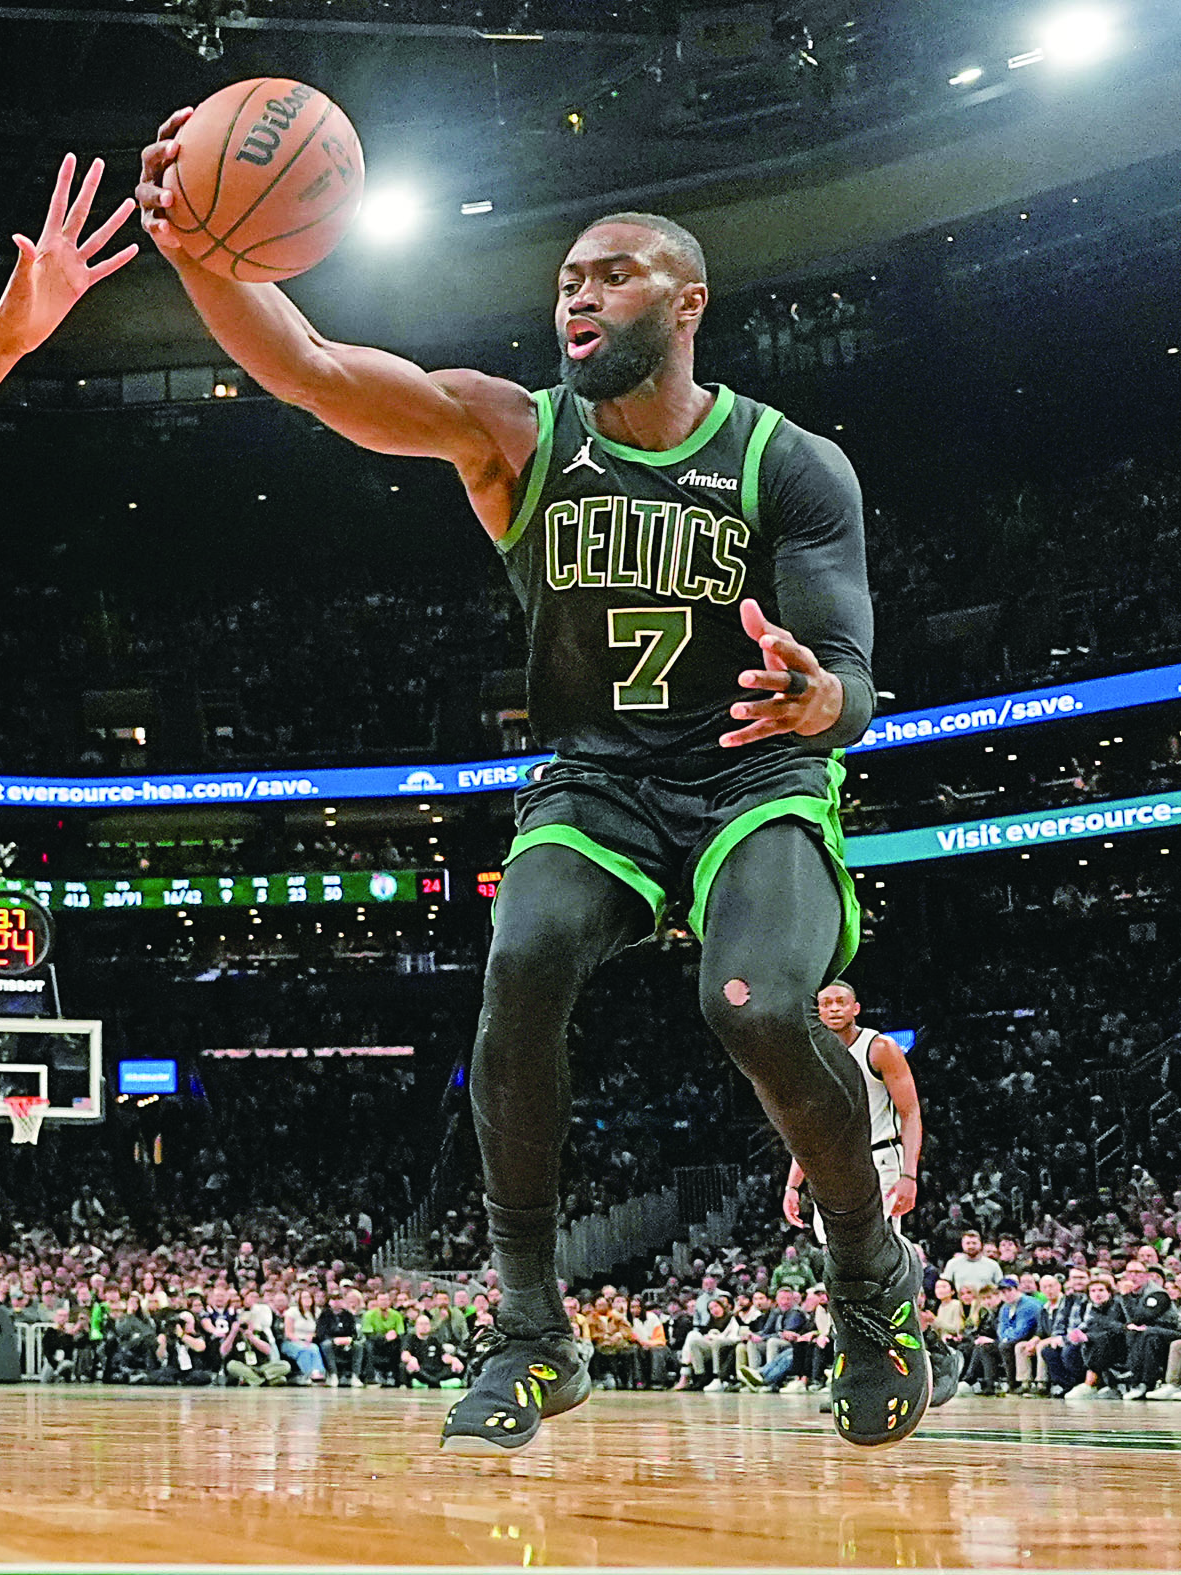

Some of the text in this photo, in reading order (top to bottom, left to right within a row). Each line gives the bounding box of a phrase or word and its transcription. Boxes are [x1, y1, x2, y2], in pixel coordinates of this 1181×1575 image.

[677, 468, 737, 491] Amica
[545, 496, 750, 605] CELTICS
[607, 606, 692, 711] 7
[854, 694, 1083, 747] e-hea.com/save.
[6, 776, 319, 802] eversource-hea.com/save.
[936, 823, 1002, 851] Visit
[422, 879, 441, 893] 24
[478, 884, 497, 898] 93
